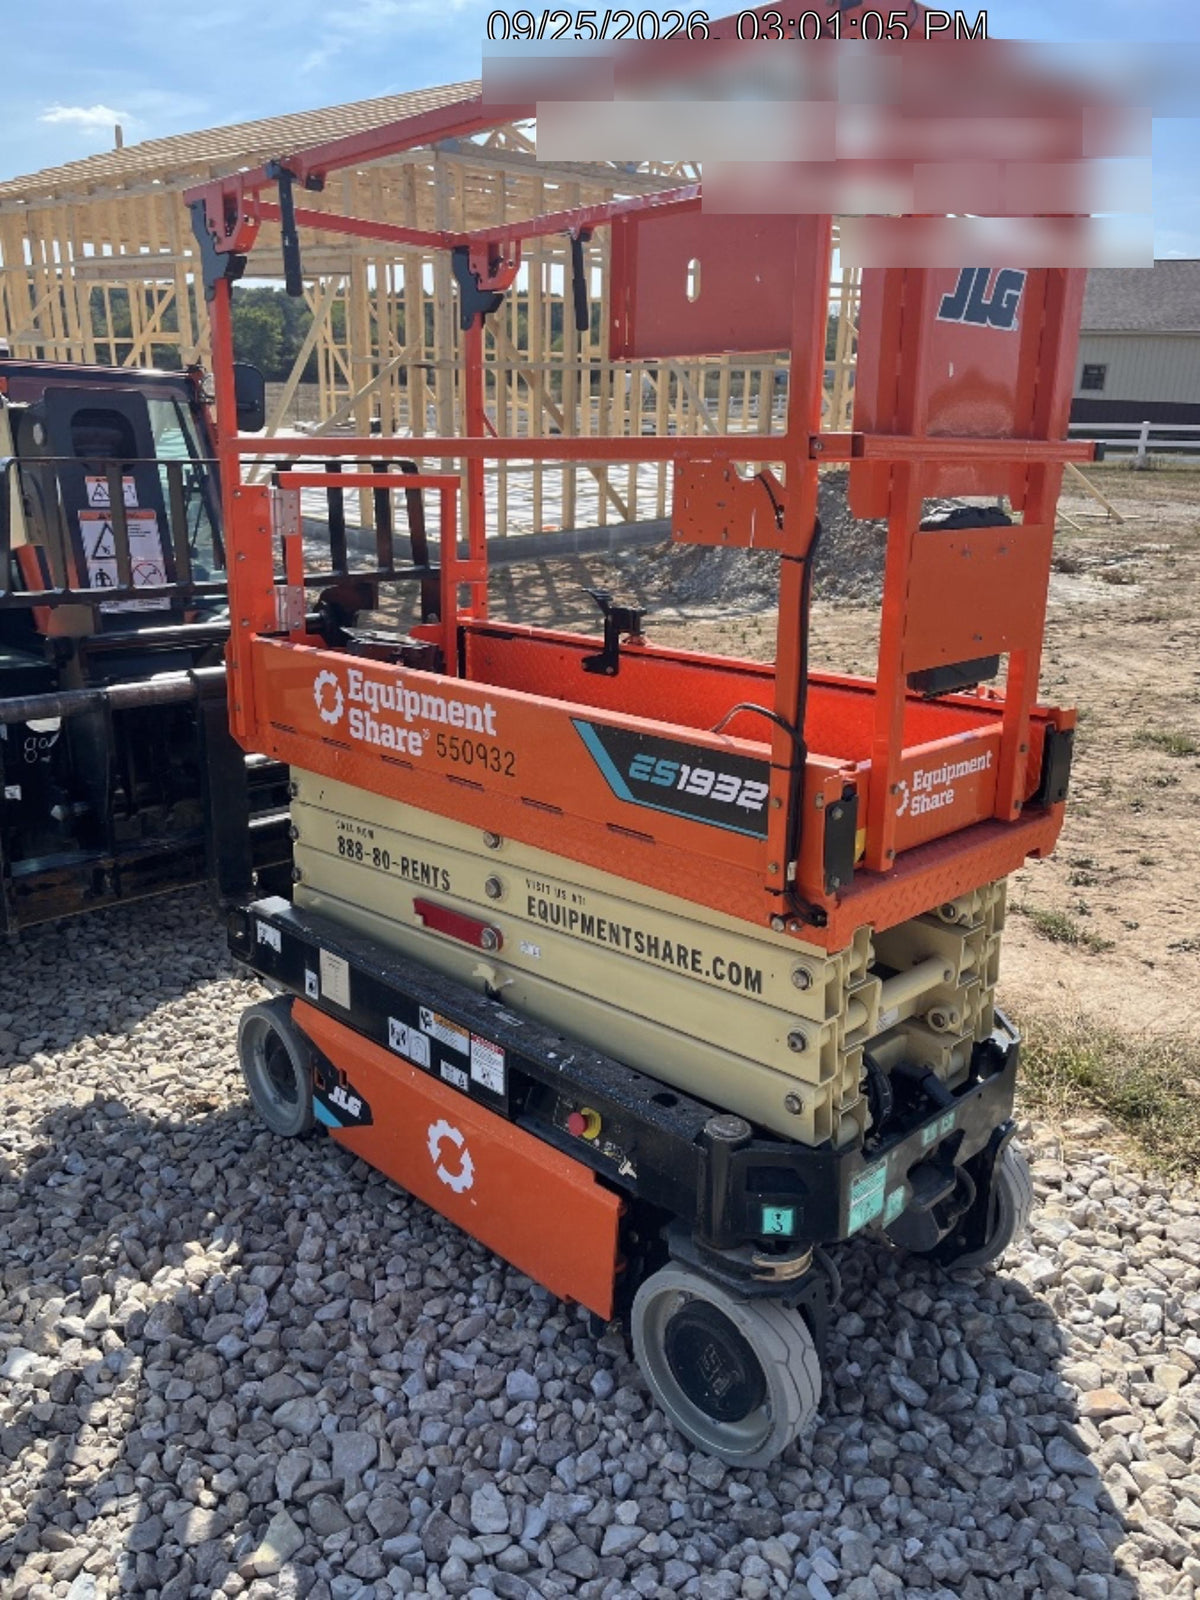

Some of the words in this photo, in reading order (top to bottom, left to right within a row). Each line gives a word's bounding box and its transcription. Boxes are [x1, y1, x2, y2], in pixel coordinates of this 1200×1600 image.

[935, 267, 1028, 331] JLG
[347, 668, 497, 736] Equipment
[436, 733, 516, 778] 550932
[912, 749, 993, 792] Equipment
[628, 752, 769, 811] ES1932
[910, 788, 954, 817] Share
[336, 834, 451, 892] 888-80-RENTS
[525, 877, 551, 895] VISIT
[554, 887, 567, 900] US
[527, 895, 763, 995] EQUIPMENTSHARE.COM
[328, 1085, 362, 1117] JLG
